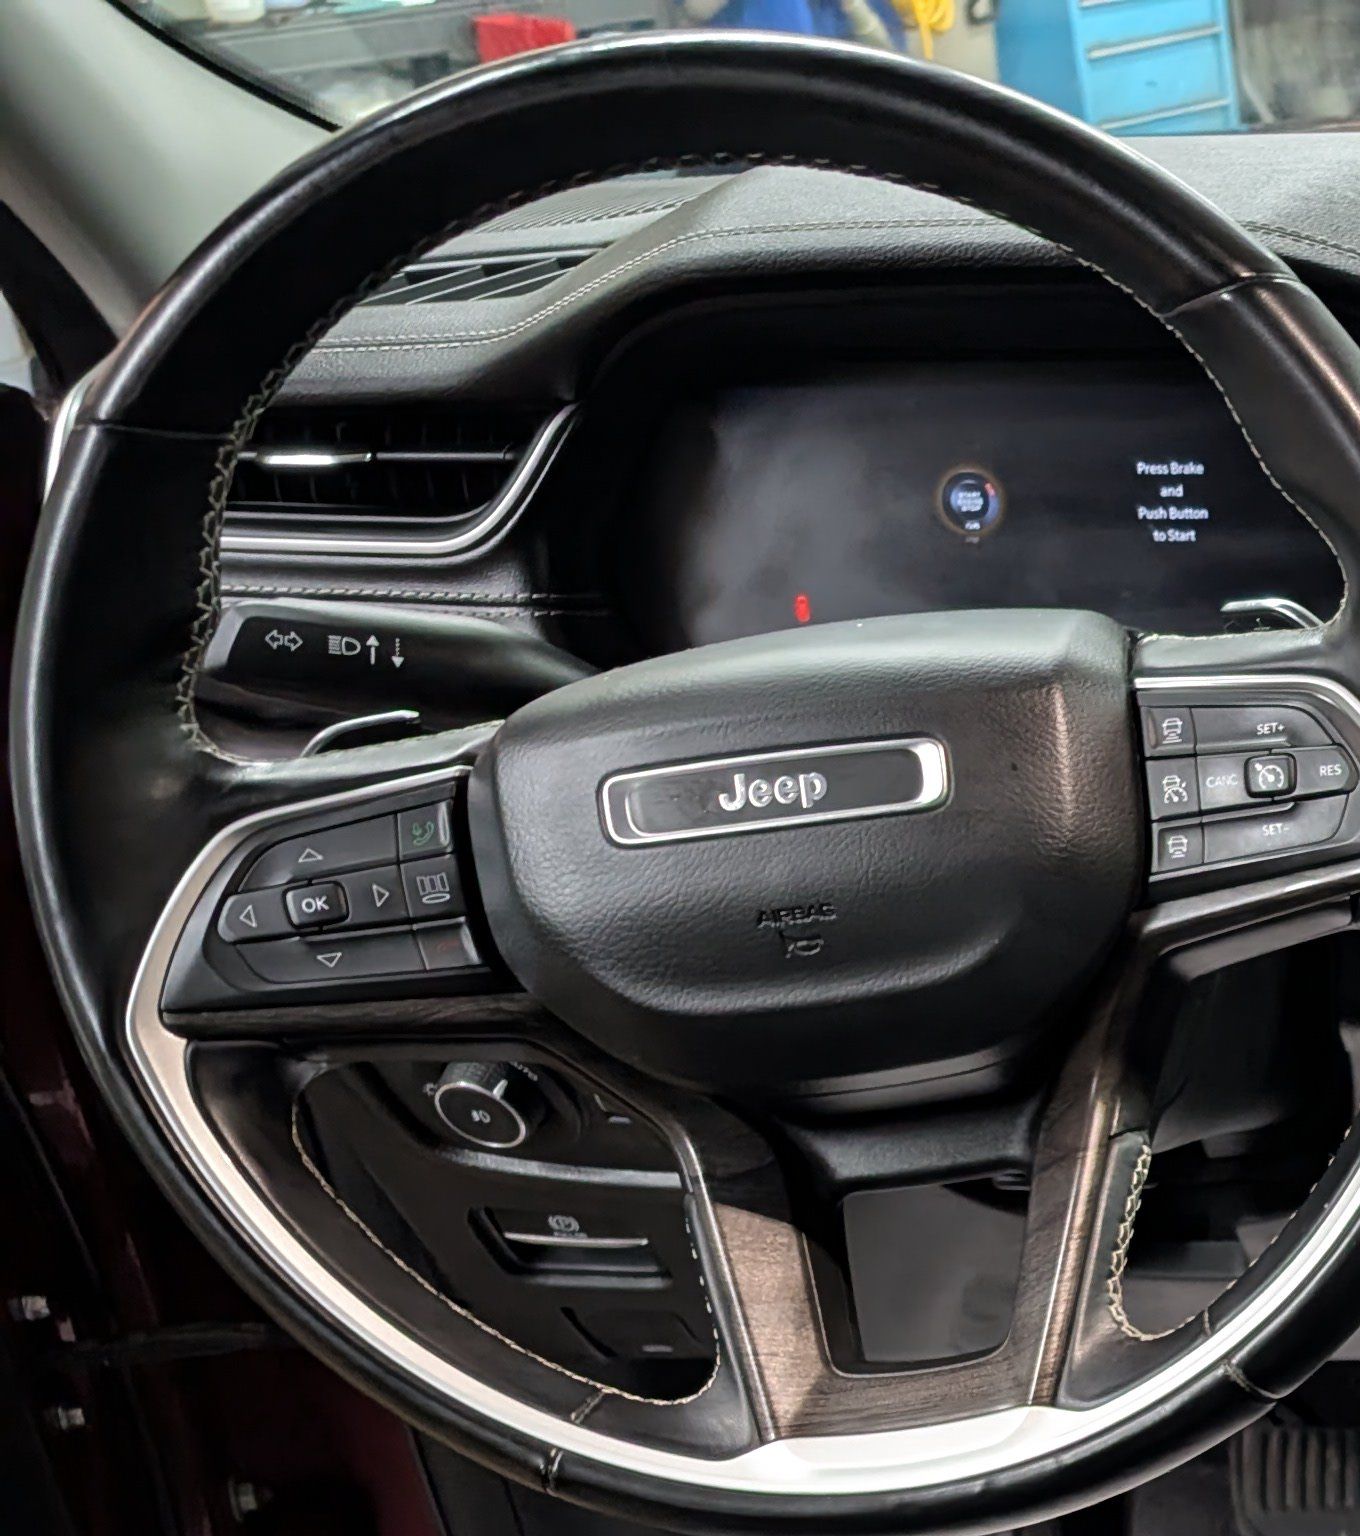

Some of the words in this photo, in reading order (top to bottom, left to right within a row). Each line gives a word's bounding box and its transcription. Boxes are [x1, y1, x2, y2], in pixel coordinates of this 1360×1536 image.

[1136, 461, 1168, 475] Press
[1170, 461, 1205, 475] Brake
[1159, 483, 1184, 497] and
[1137, 506, 1167, 520] Push
[1169, 506, 1209, 520] Button
[1152, 530, 1166, 542] to
[1167, 529, 1197, 542] Start
[1256, 722, 1286, 735] SET+
[1319, 764, 1342, 777] RES
[1205, 774, 1239, 788] CANC
[718, 771, 828, 812] Jeep
[301, 895, 330, 914] OK
[757, 902, 838, 929] AIRBAG
